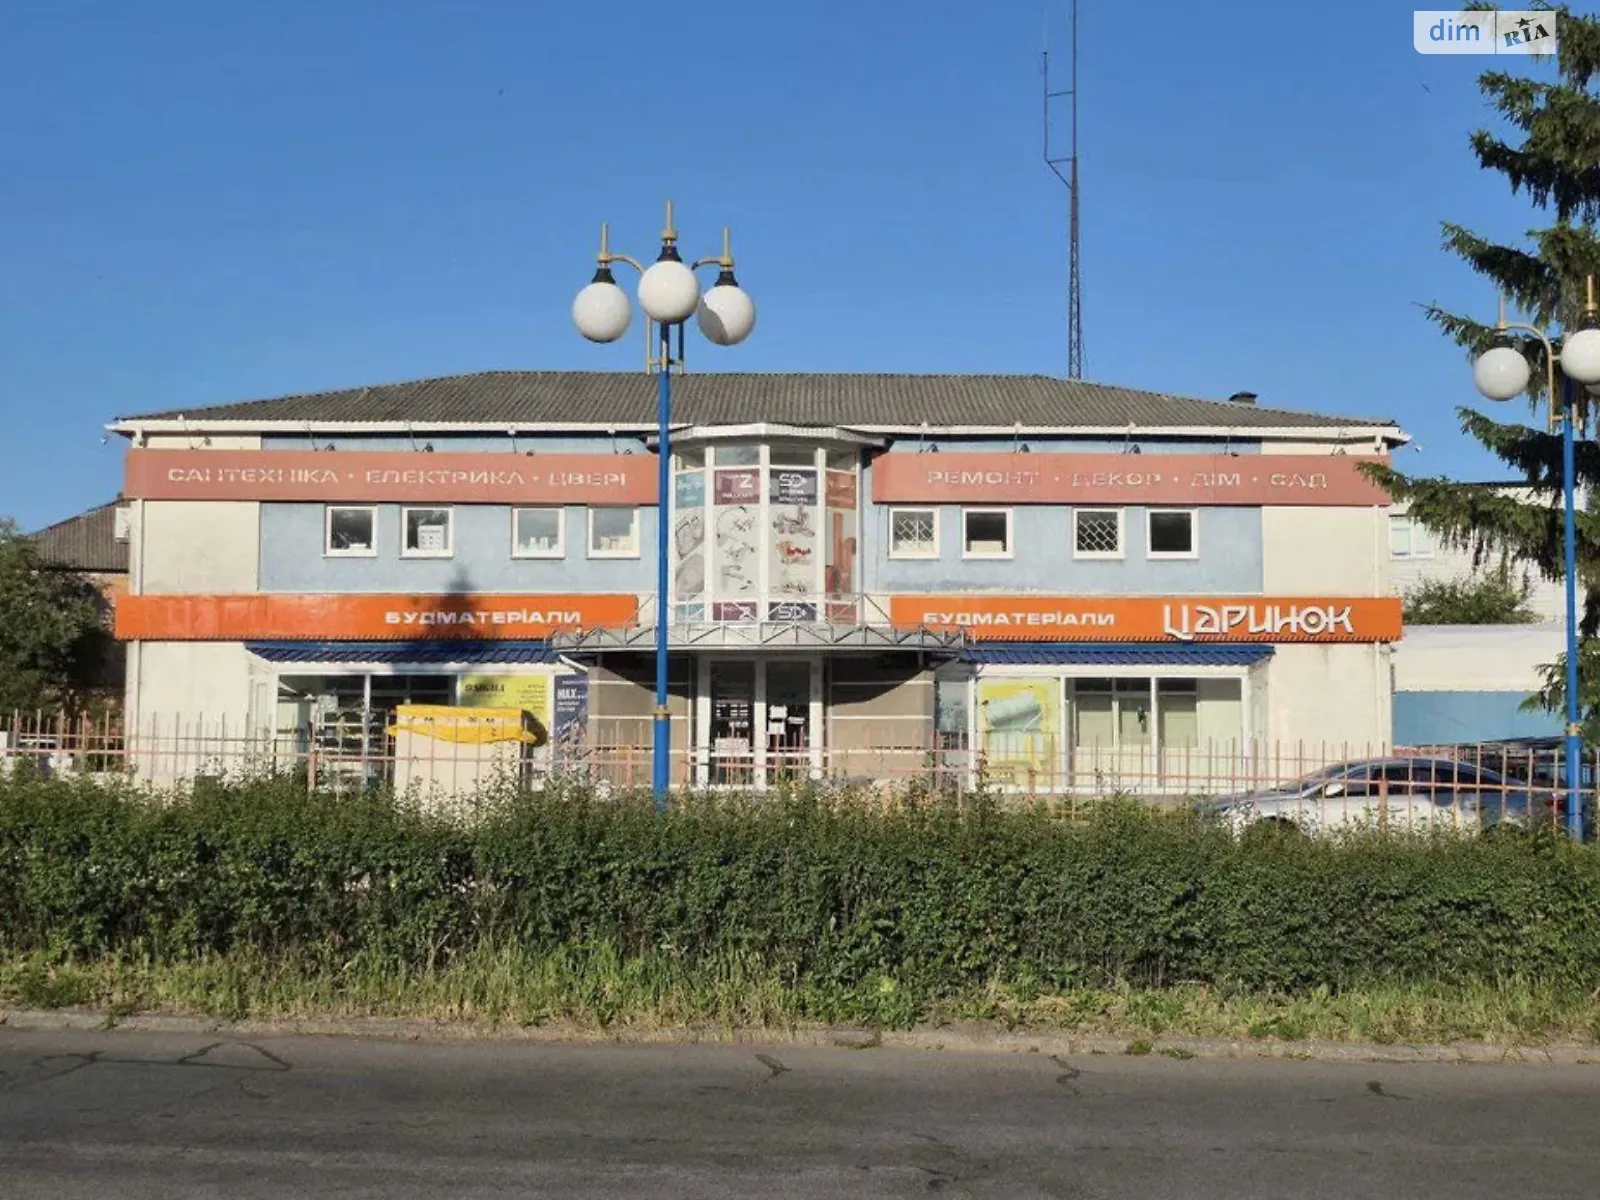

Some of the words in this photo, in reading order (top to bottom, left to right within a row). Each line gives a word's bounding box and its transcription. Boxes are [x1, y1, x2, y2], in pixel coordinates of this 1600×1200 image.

[167, 468, 340, 483] САНТЕХНІКА
[365, 469, 526, 486] ЕЛЕКТРИКА
[927, 470, 1040, 485] РЕМОНТ
[1270, 472, 1328, 489] САД
[384, 608, 582, 625] БУДМАТЕРІАЛИ
[922, 609, 1115, 626] БУДМАТЕРІАЛИ
